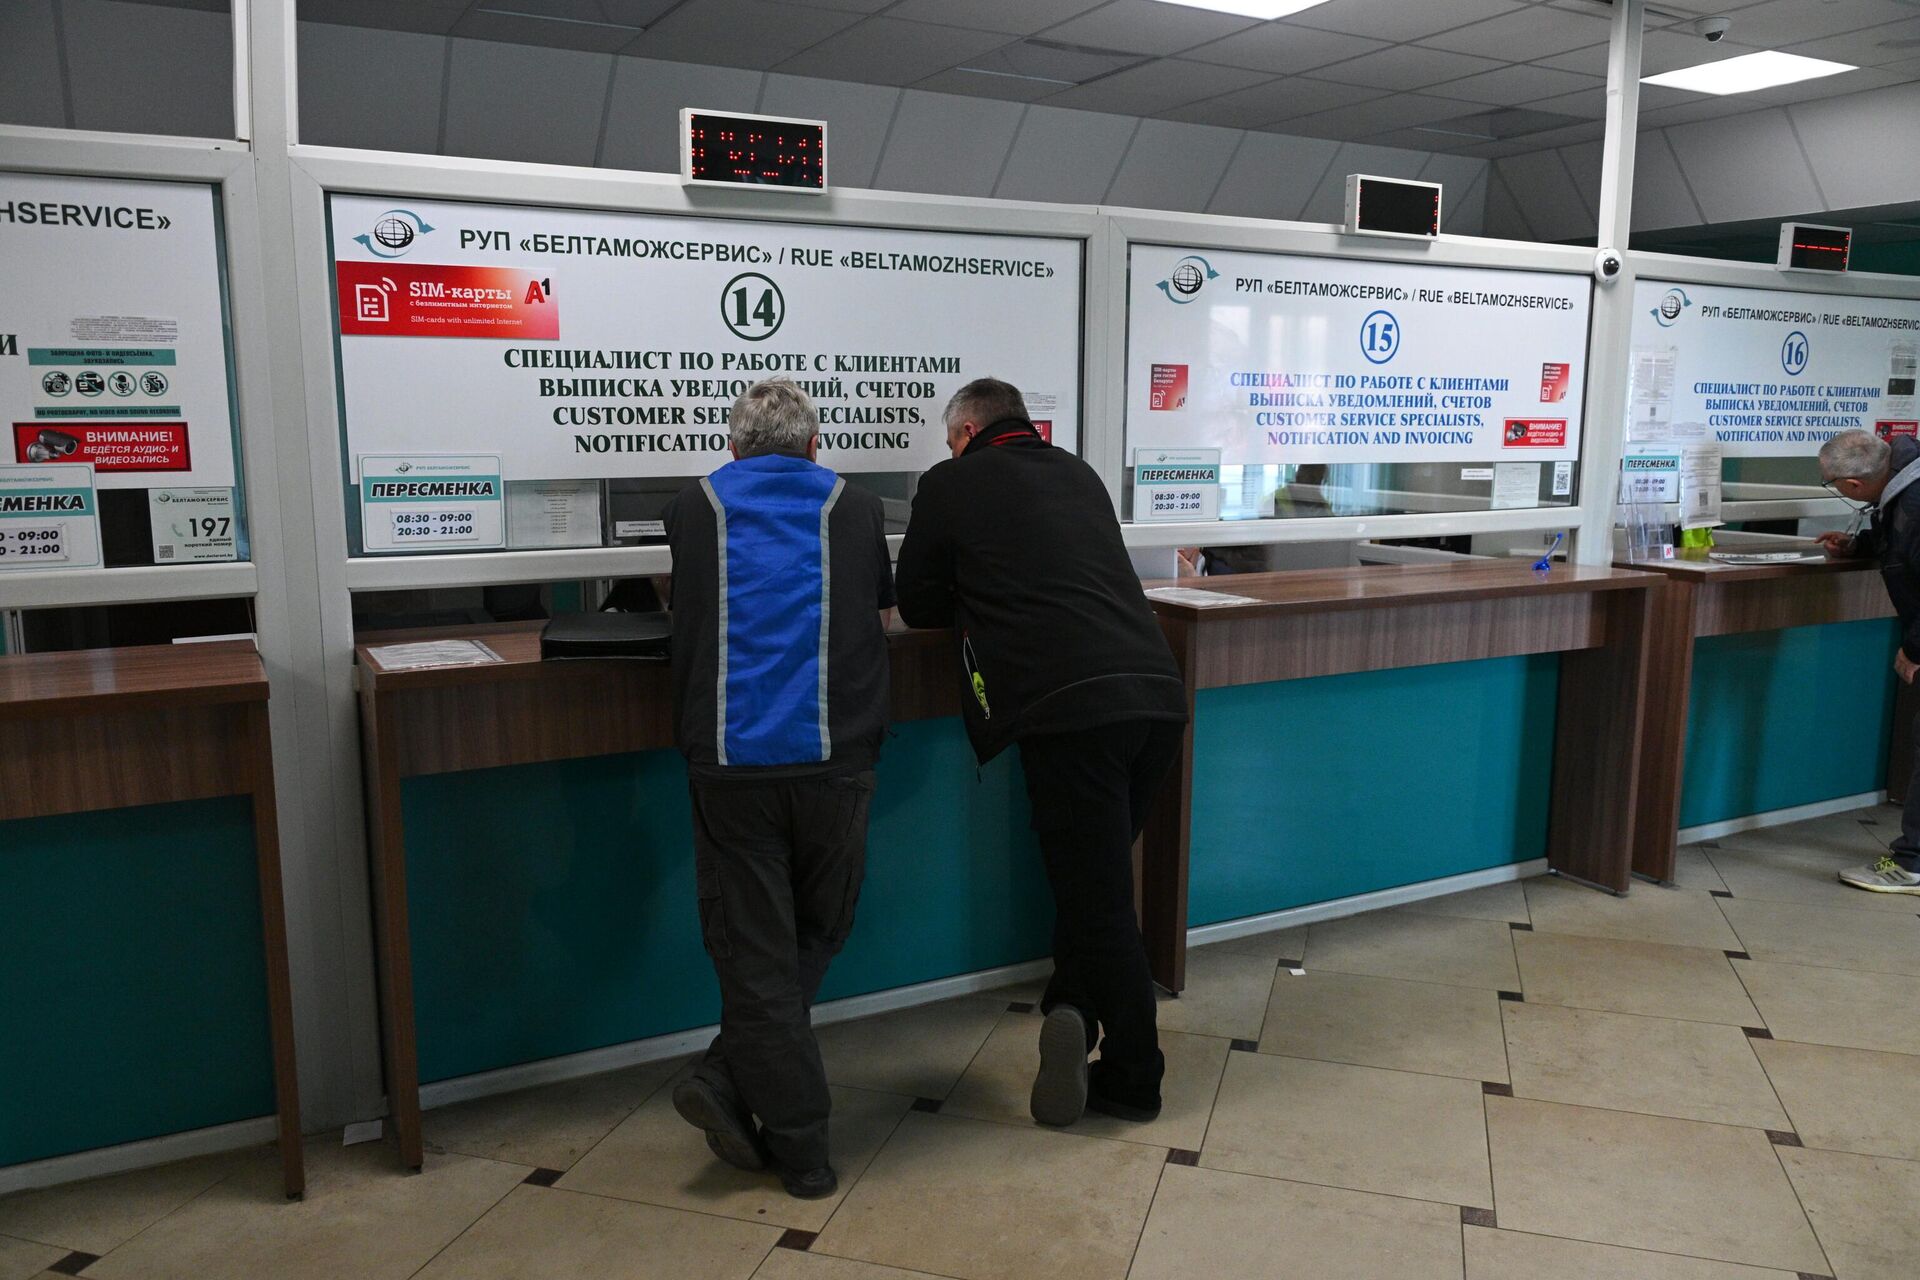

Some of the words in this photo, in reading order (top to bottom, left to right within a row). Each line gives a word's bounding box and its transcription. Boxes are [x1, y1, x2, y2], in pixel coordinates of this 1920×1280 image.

[460, 229, 510, 251] РУП
[520, 233, 772, 264] «БЕЛТАМОЖСЕРВИС»
[779, 247, 784, 264] /
[791, 249, 833, 267] RUE
[840, 251, 1054, 279] «BELTAMOZHSERVICE»
[409, 282, 511, 302] SIM-карты
[1236, 278, 1262, 292] РУП
[1267, 280, 1408, 301] «БЕЛТАМОЖСЕРВИС»
[1412, 289, 1416, 301] /
[1419, 290, 1443, 303] RUE
[1447, 292, 1574, 310] «BELTAMOZHSERVICE»
[415, 301, 467, 309] безлимитным
[469, 302, 512, 310] интернетом
[732, 286, 775, 327] 14
[411, 315, 445, 324] SIM-cards
[447, 316, 462, 324] with
[463, 317, 495, 325] unlimited
[496, 318, 523, 326] Internet
[1702, 306, 1720, 317] РУП
[1722, 307, 1817, 324] «БЕЛТАМОЖСЕРВИС»
[1818, 313, 1822, 324] /
[1823, 314, 1840, 325] RUE
[1842, 315, 1920, 331] «BELTAMOZHSERVIC
[1367, 323, 1393, 352] 15
[504, 349, 672, 372] СПЕЦИАЛИСТ
[680, 352, 714, 370] ПО
[722, 353, 806, 371] РАБОТЕ
[814, 354, 827, 372] С
[835, 355, 961, 373] КЛИЕНТАМИ
[1786, 341, 1804, 365] 16
[539, 378, 664, 397] ВЫПИСКА
[855, 381, 936, 399] СЧЕТОВ
[1230, 372, 1331, 390] СПЕЦИАЛИСТ
[1335, 375, 1356, 389] ПО
[1360, 376, 1413, 390] РАБОТЕ
[1417, 377, 1426, 390] С
[1429, 377, 1509, 392] КЛИЕНТАМИ
[1693, 382, 1761, 396] СПЕЦИАЛИСТ
[1763, 384, 1778, 396] ПО
[1780, 385, 1816, 397] РАБОТЕ
[1818, 386, 1824, 397] С
[1826, 386, 1881, 398] КЛИЕНТАМИ
[1249, 393, 1324, 407] ВЫПИСКА
[1328, 393, 1437, 410] УВЕДОМЛЕНИЙ,
[1441, 396, 1492, 409] СЧЕТОВ
[1705, 399, 1755, 411] ВЫПИСКА
[1757, 399, 1831, 414] УВЕДОМЛЕНИЙ,
[1833, 401, 1868, 412] СЧЕТОВ
[553, 406, 686, 425] CUSTOMER
[817, 406, 926, 427] ECIALISTS,
[1256, 412, 1336, 426] CUSTOMER
[1340, 413, 1396, 426] SERVICE
[1400, 413, 1484, 428] SPECIALISTS,
[1709, 415, 1762, 427] CUSTOMER
[1766, 415, 1803, 427] SERVICE
[1805, 415, 1862, 428] SPECIALISTS,
[86, 431, 173, 443] ВНИМАНИЕ!
[817, 432, 910, 449] VOICING
[1268, 431, 1369, 445] NOTIFICATION
[1372, 431, 1400, 445] AND
[1404, 431, 1473, 445] INVOICING
[1715, 430, 1784, 442] NOTIFICATION
[1785, 430, 1805, 442] AND
[84, 445, 130, 454] ВЕДЁТСЯ
[133, 445, 169, 454] АУДИО-
[95, 456, 170, 465] ВИДЕОЗАПИСЬ
[1627, 460, 1676, 469] ПЕРЕСМЕНКА
[1141, 469, 1215, 481] ПЕРЕСМЕНКА
[371, 481, 494, 498] ПЕРЕСМЕНКА
[1154, 493, 1175, 501] 08:30
[0, 495, 84, 512] МЕНКА
[396, 513, 429, 524] 08:30
[439, 512, 472, 523] 09:00
[189, 517, 230, 537] 197
[397, 525, 430, 537] 20:30
[440, 525, 473, 536] 21:00
[18, 531, 59, 541] 09:00
[20, 544, 60, 555] 21:00
